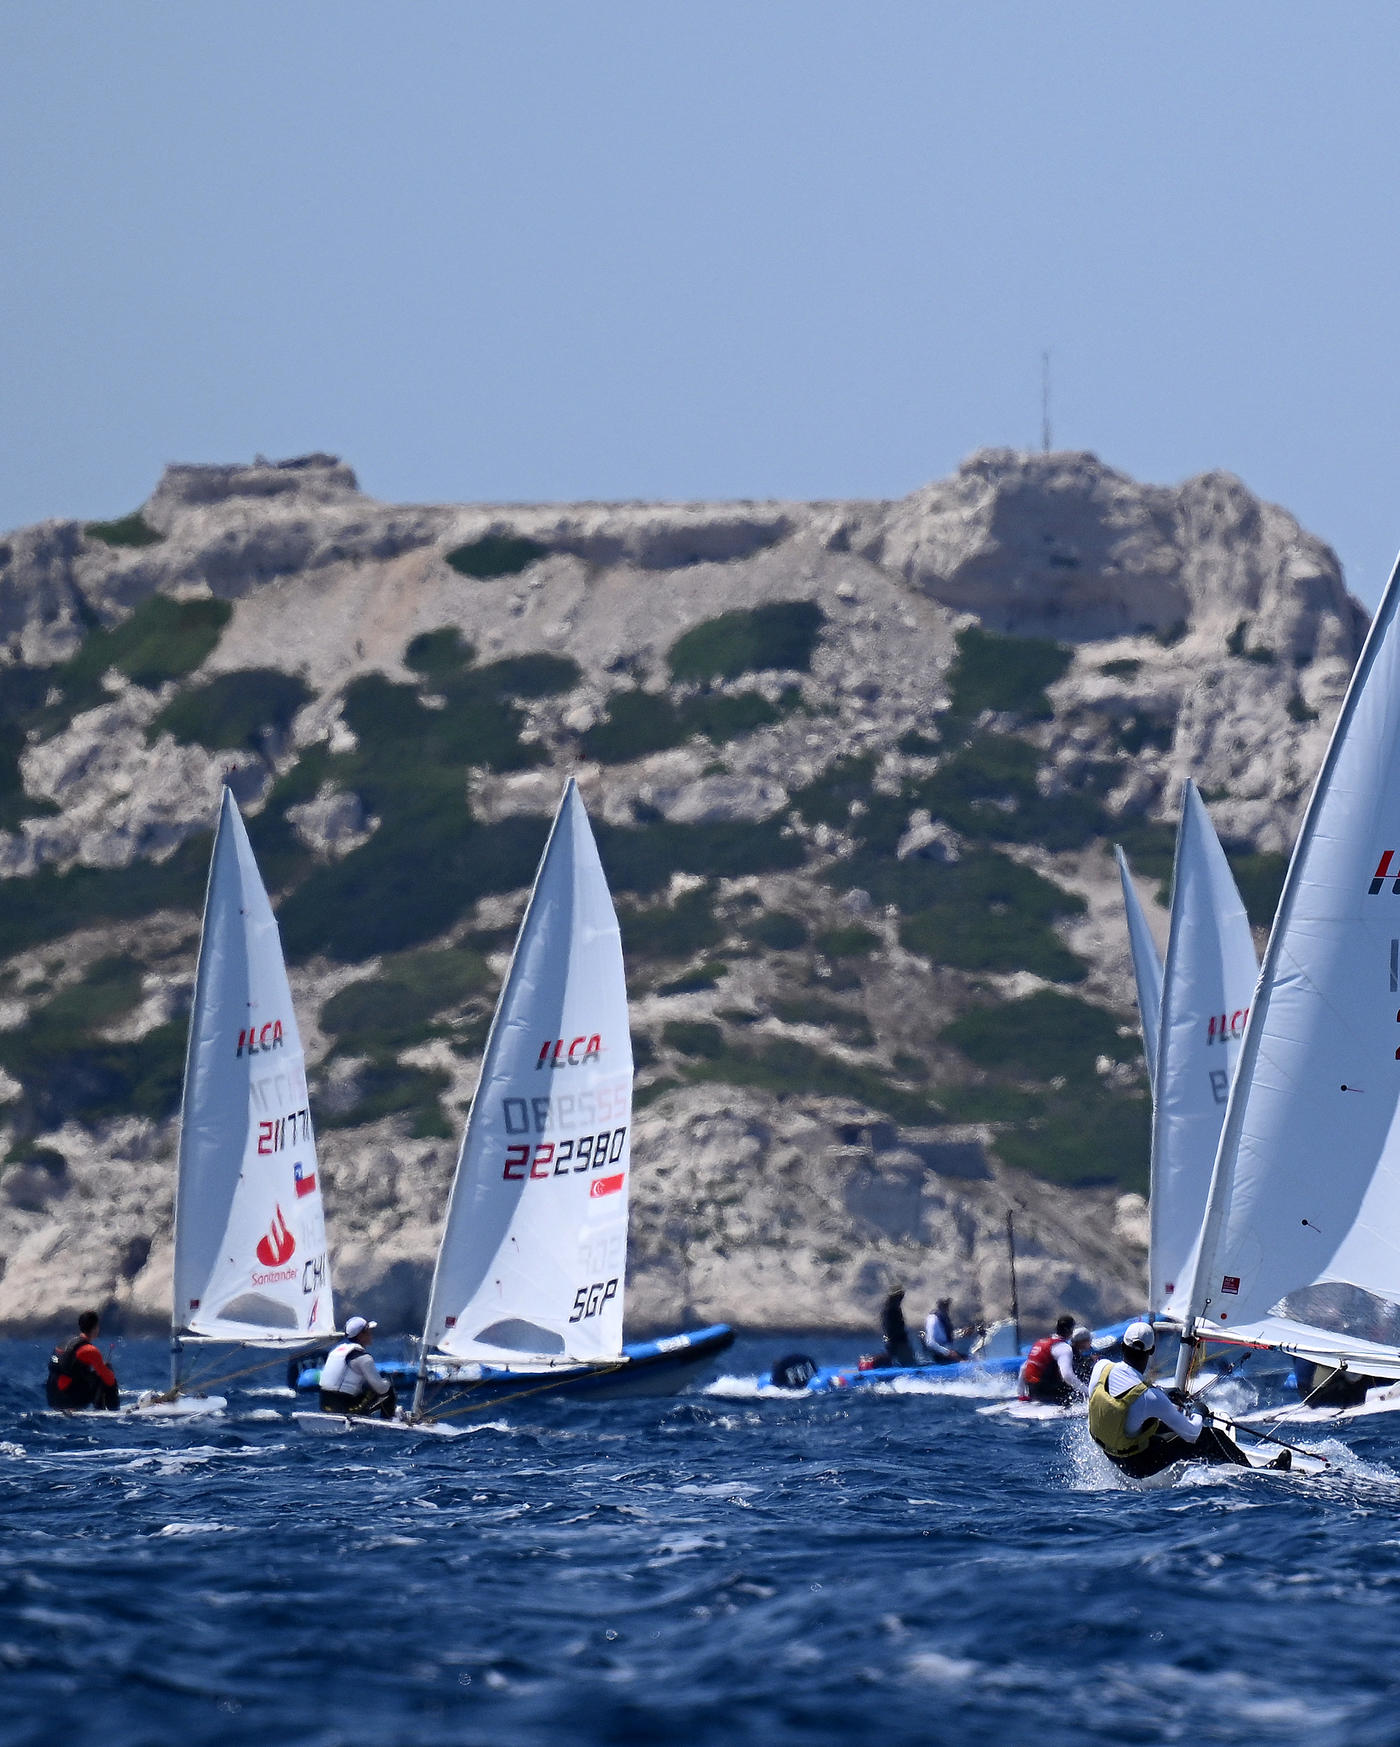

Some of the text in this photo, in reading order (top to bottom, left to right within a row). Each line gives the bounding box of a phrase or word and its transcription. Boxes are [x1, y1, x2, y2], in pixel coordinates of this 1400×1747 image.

[236, 1019, 283, 1058] ILCA
[536, 1033, 602, 1070] ILCA
[503, 1127, 627, 1181] 222980
[251, 1268, 297, 1287] Santander
[569, 1278, 619, 1323] SGP
